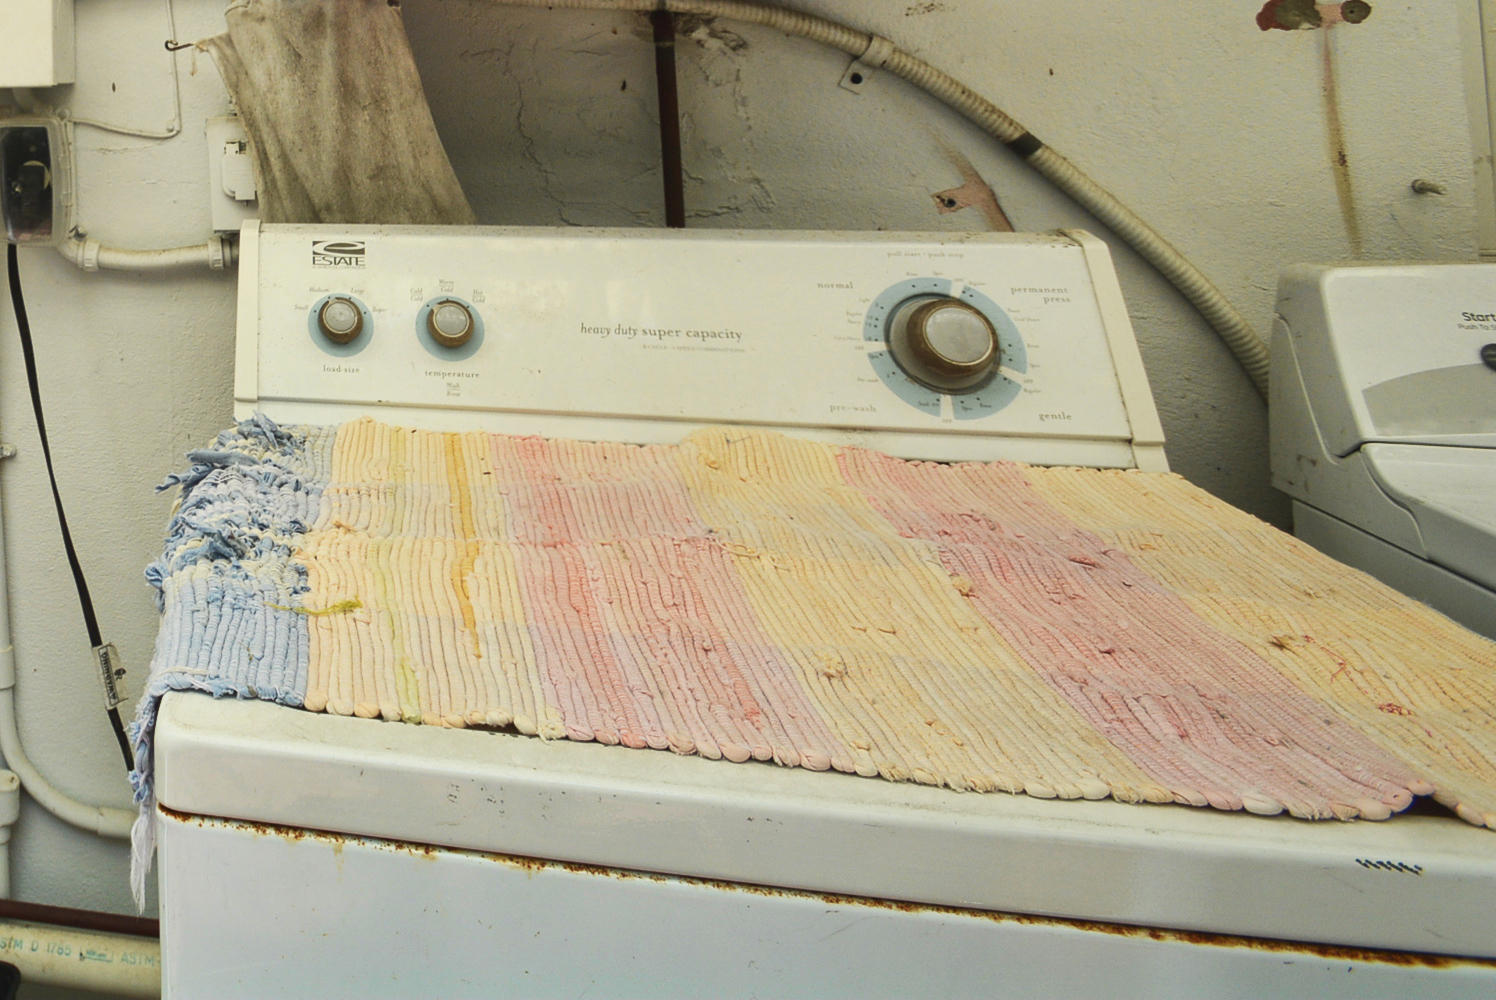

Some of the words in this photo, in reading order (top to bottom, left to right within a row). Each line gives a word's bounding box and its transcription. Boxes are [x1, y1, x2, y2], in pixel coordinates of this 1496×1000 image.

[312, 256, 365, 266] ESTATE
[817, 281, 854, 289] normal
[1010, 286, 1068, 295] permanent
[1043, 296, 1071, 304] press
[580, 322, 611, 338] heavy
[614, 323, 638, 340] duty
[642, 328, 682, 340] super
[686, 328, 743, 343] capacity
[424, 370, 480, 380] temperature
[829, 404, 877, 414] pre-wash
[1038, 412, 1073, 422] gentle
[120, 951, 155, 967] ASTM
